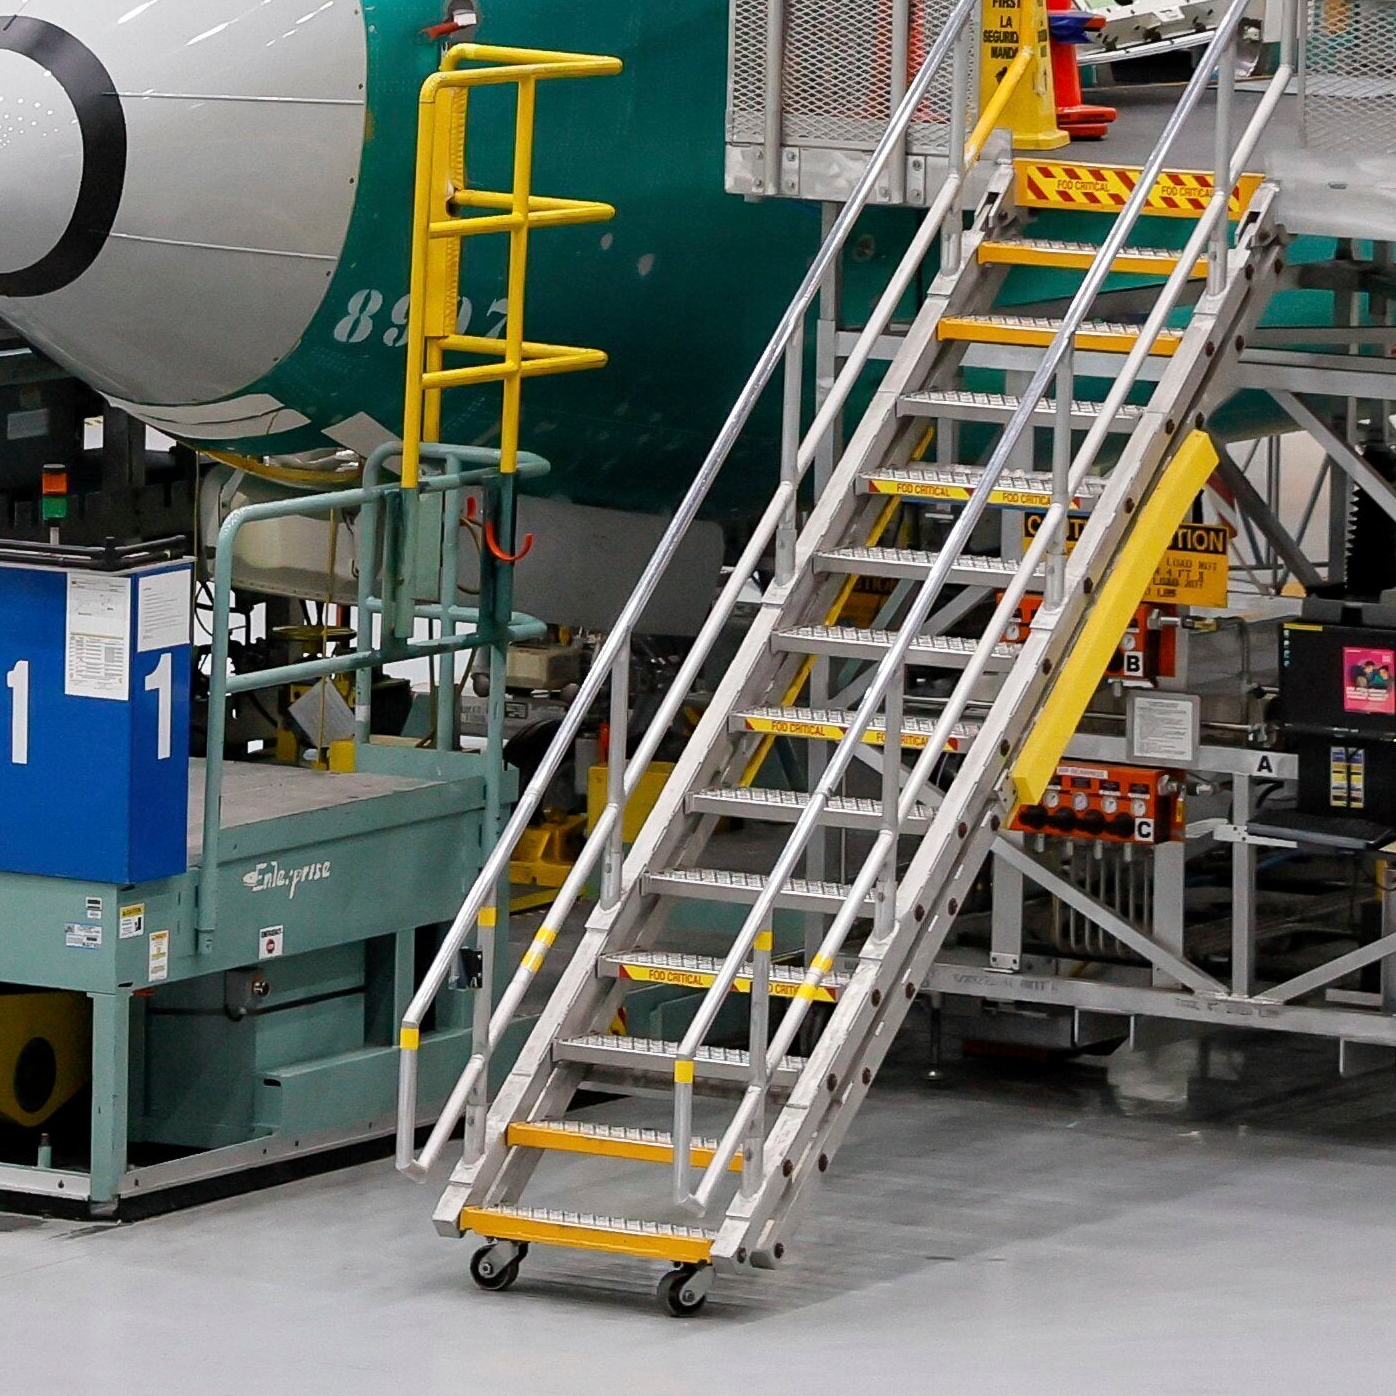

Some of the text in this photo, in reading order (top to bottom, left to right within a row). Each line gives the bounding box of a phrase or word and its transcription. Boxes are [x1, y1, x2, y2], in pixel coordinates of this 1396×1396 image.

[1000, 15, 1013, 28] LA
[1056, 179, 1109, 193] FOD CRITICAL
[1161, 185, 1177, 197] FOD
[896, 482, 951, 497] FOD CRITICAL
[1002, 491, 1053, 505] FOD CRITICA
[1175, 529, 1225, 553] TION
[1127, 655, 1140, 672] B
[6, 660, 29, 765] 1
[145, 652, 172, 759] 1
[771, 720, 825, 736] FOD CRITICAL
[1257, 755, 1273, 773] A
[1137, 820, 1151, 838] C
[649, 969, 703, 986] FOD CRITICAL
